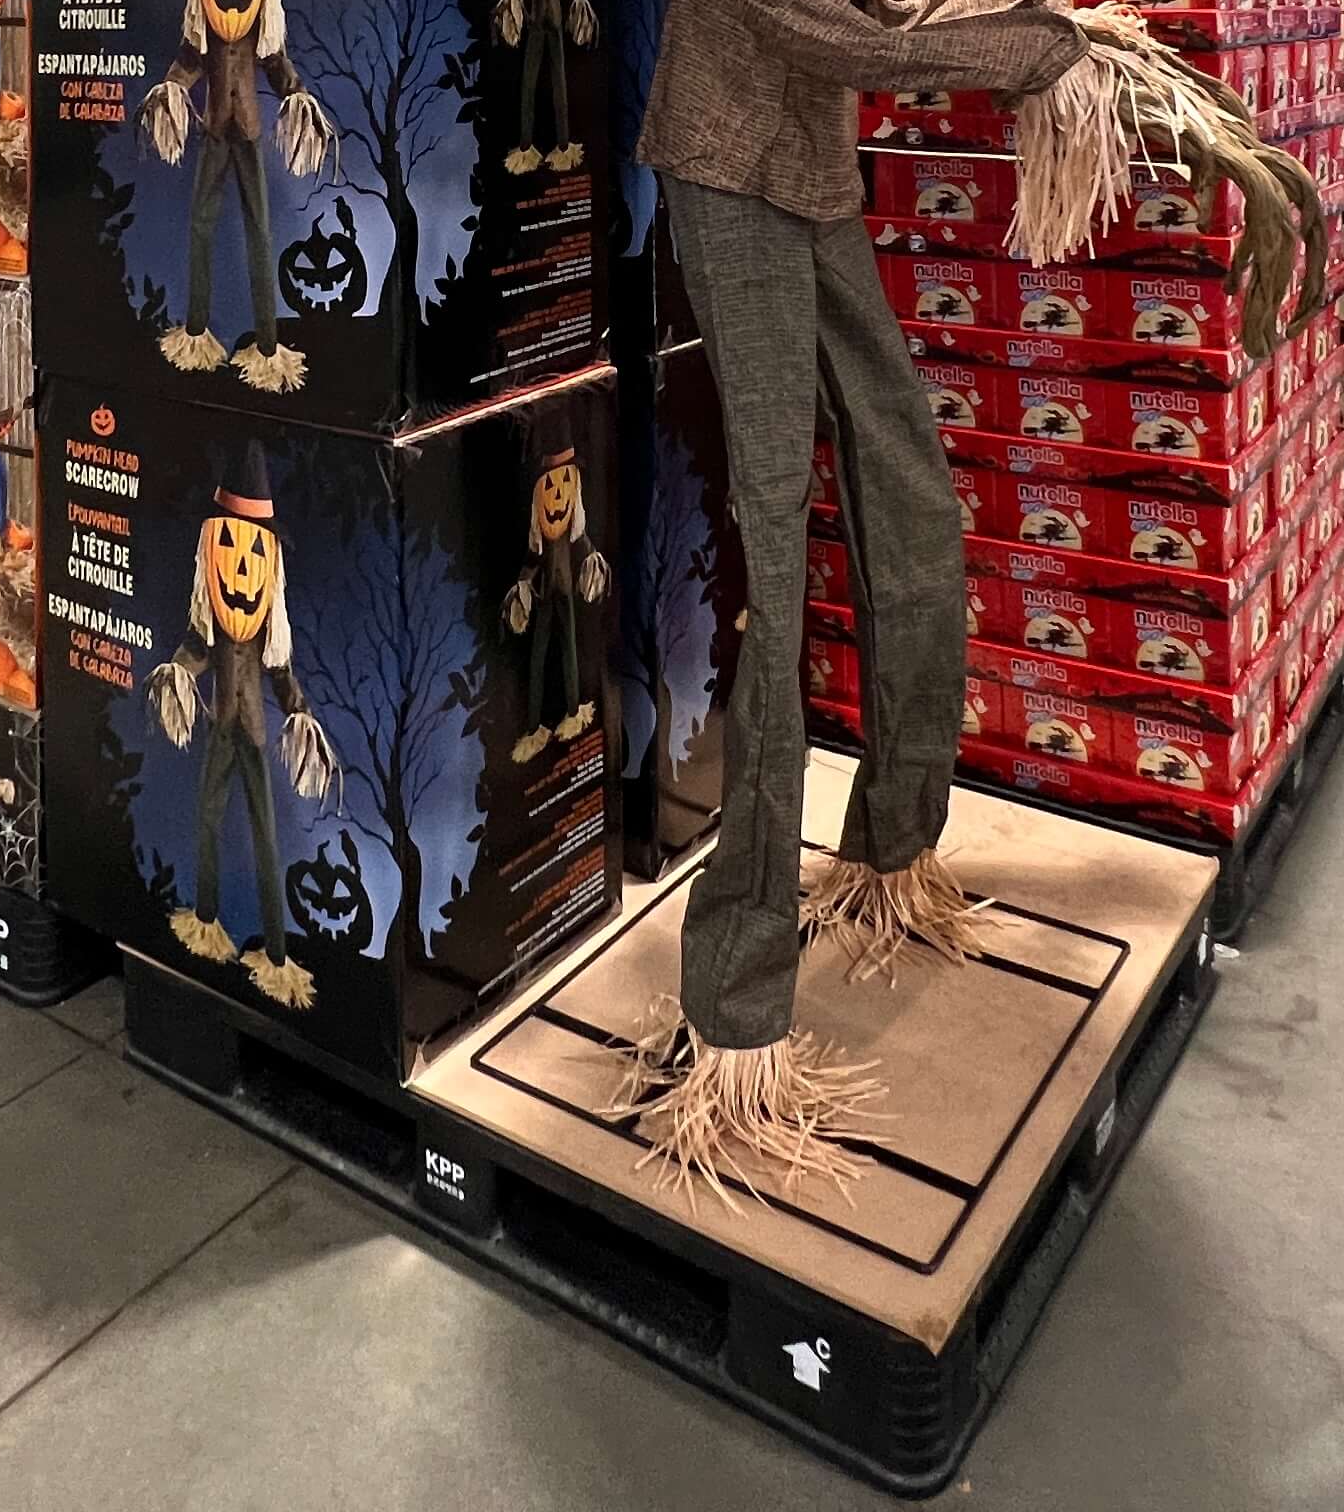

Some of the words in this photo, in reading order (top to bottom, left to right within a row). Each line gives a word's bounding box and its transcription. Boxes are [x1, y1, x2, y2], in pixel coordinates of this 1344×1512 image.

[59, 8, 126, 31] CITROUILLE
[38, 47, 146, 77] ESPANTAPÁJAROS
[60, 81, 82, 99] CON
[913, 159, 974, 179] nutella
[914, 262, 974, 282] nutella
[1018, 270, 1083, 291] nutella
[1132, 279, 1200, 300] nutella
[1008, 339, 1062, 357] nutella
[917, 365, 975, 386] nutella
[1018, 377, 1083, 399] nutella
[1130, 391, 1199, 413] nutella
[66, 439, 111, 465] PUMPKIN
[114, 449, 139, 473] HEAD
[1008, 445, 1063, 465] nutella
[65, 460, 139, 499] SCARECROW
[1018, 483, 1082, 506] nutella
[1129, 500, 1197, 525] nutella
[71, 525, 80, 553] À
[82, 531, 110, 563] TÊTE
[114, 544, 130, 568] DE
[1009, 553, 1064, 574] nutella
[68, 555, 133, 596] CITROUILLE
[1024, 588, 1086, 613] nutella
[48, 592, 153, 650] ESPANTAPÁJAROS
[1135, 609, 1203, 635] nutella
[71, 629, 91, 651] CON
[1011, 658, 1067, 682] nutella
[1024, 691, 1087, 720] nutella
[1135, 718, 1203, 746] nutella
[1014, 760, 1069, 786] nutella
[425, 1148, 465, 1184] KPP
[816, 1337, 831, 1359] C
